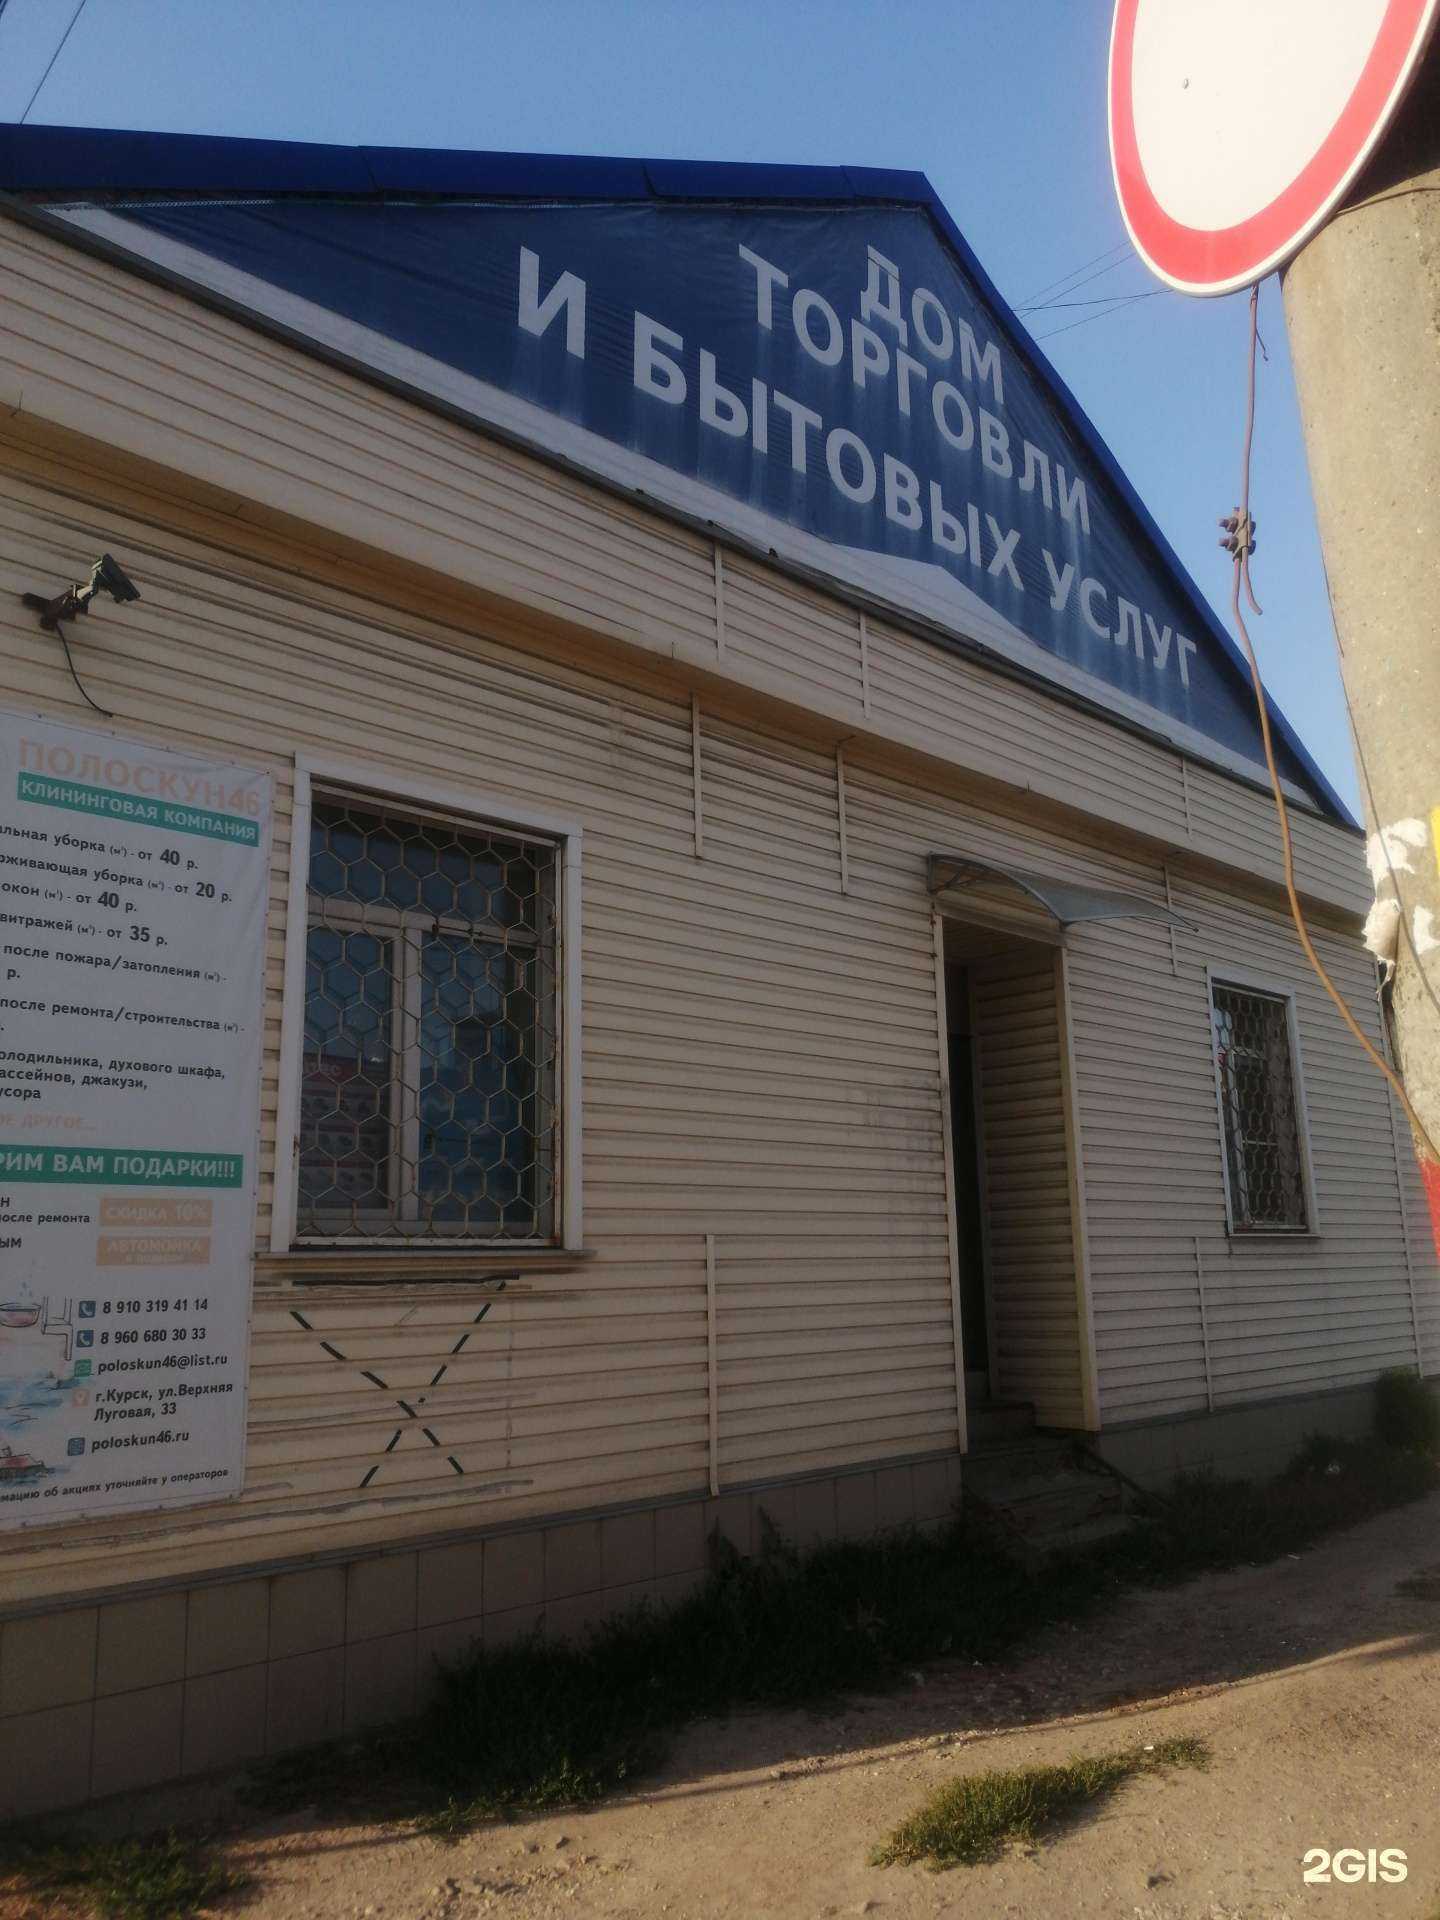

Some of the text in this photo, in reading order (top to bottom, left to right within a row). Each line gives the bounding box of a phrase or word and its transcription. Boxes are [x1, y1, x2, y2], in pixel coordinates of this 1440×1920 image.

[860, 245, 1004, 403] ДОМ
[739, 244, 1089, 534] ТОРГОВЛИ
[518, 246, 1197, 688] И БЫТОВЫХ УСЛУГ
[19, 737, 260, 818] ПОЛОСКУН46
[22, 779, 257, 840] КЛИНИНГОВАЯ КОМПАНИЯ
[54, 831, 105, 853] уборка
[138, 850, 152, 861] от
[160, 849, 180, 866] 40
[187, 859, 199, 871] р.
[2, 883, 39, 897] окон
[76, 893, 91, 904] от
[97, 891, 119, 909] 40
[125, 901, 137, 912] р.
[94, 869, 143, 888] уборка
[174, 883, 188, 894] от
[195, 882, 215, 899] 20
[221, 892, 232, 903] р.
[0, 914, 73, 932] витражей
[107, 927, 122, 938] от
[129, 926, 150, 942] 35
[156, 935, 168, 946] р.
[4, 944, 49, 959] после
[55, 950, 200, 979] пожара/затопления
[0, 998, 46, 1012] после
[52, 1003, 220, 1030] ремонта/строительства
[81, 1074, 148, 1091] джакузи,
[108, 1059, 172, 1075] духового
[178, 1065, 225, 1080] шкафа,
[53, 1155, 104, 1173] ВАМ
[113, 1157, 235, 1179] ПОДАРКИ!!!
[0, 1213, 90, 1225] осле ремонта
[103, 1298, 208, 1314] 8 910 319 41 14
[101, 1328, 206, 1344] 8 960 680 30 33
[98, 1353, 227, 1375] poloskun46@list.ru
[95, 1382, 233, 1405] г.Курск, ул.Верхняя
[94, 1402, 177, 1423] Луговая, 33
[91, 1430, 189, 1453] poloskun46.ru
[44, 1486, 58, 1498] об
[62, 1482, 101, 1496] акциях
[161, 1475, 168, 1486] у
[171, 1468, 229, 1484] операторов
